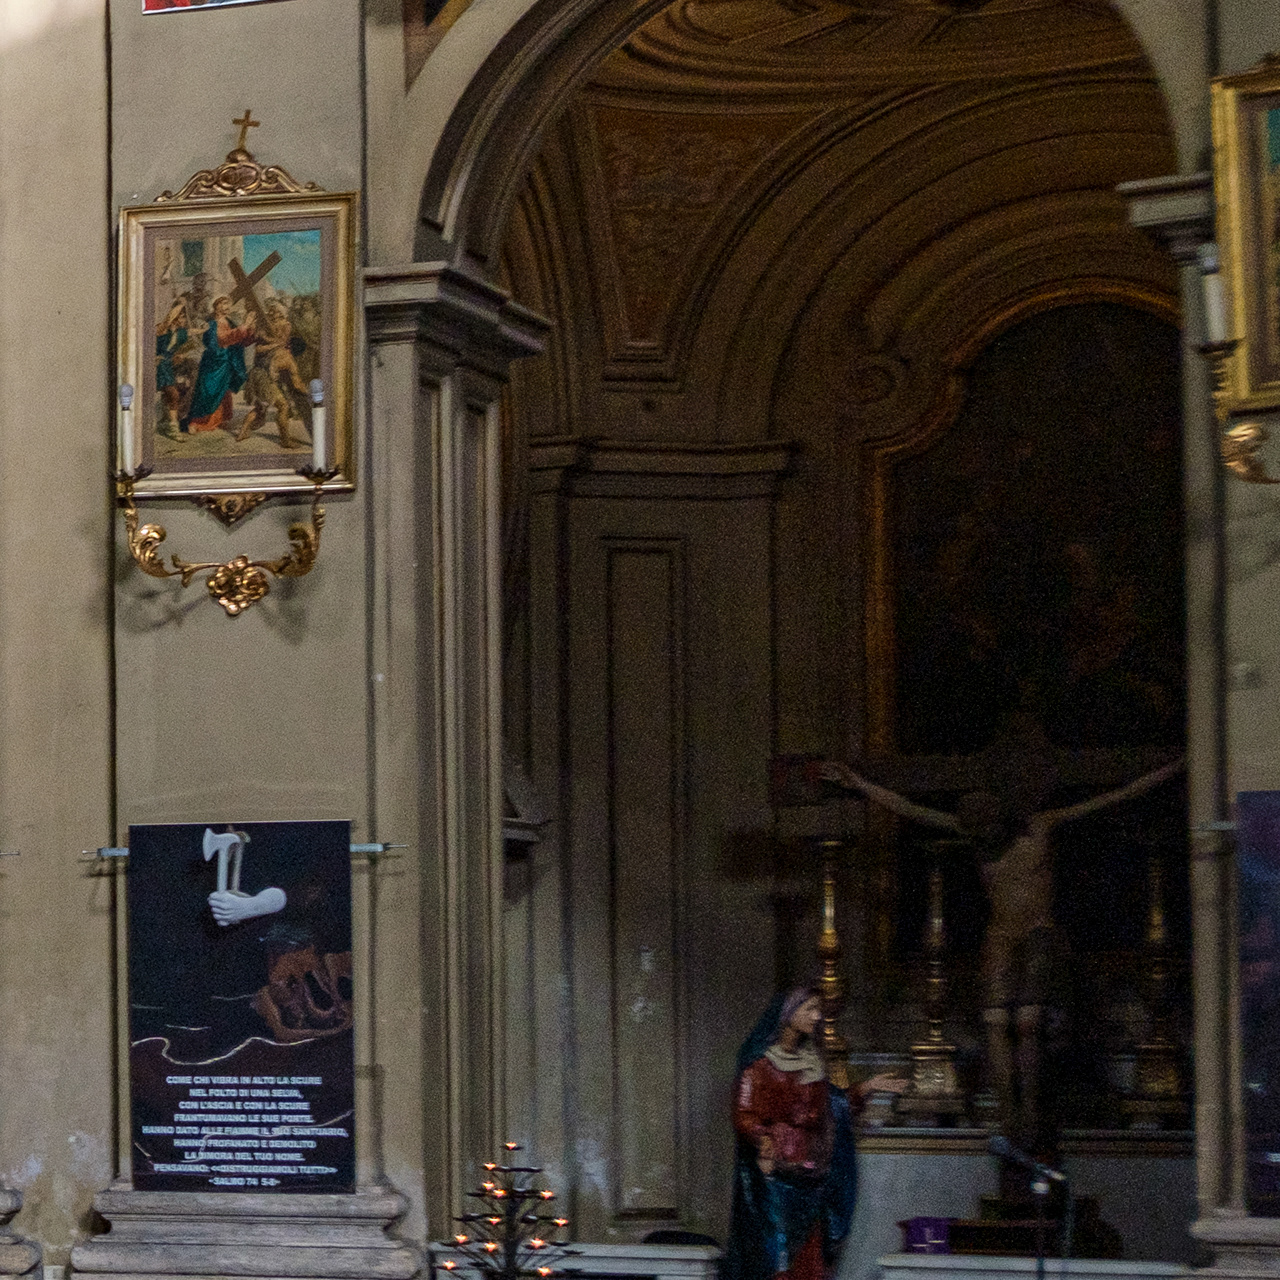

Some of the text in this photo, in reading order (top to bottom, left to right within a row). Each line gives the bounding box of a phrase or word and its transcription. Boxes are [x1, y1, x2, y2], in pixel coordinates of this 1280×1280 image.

[252, 1076, 275, 1084] ALTO
[276, 1076, 289, 1084] LA
[189, 1089, 207, 1097] NEL
[209, 1089, 237, 1097] FOLTO
[251, 1089, 270, 1097] UNA
[179, 1102, 198, 1110] CON
[236, 1102, 242, 1110] E
[244, 1102, 263, 1110] CON
[265, 1102, 277, 1110] LA
[176, 1126, 200, 1134] DATO
